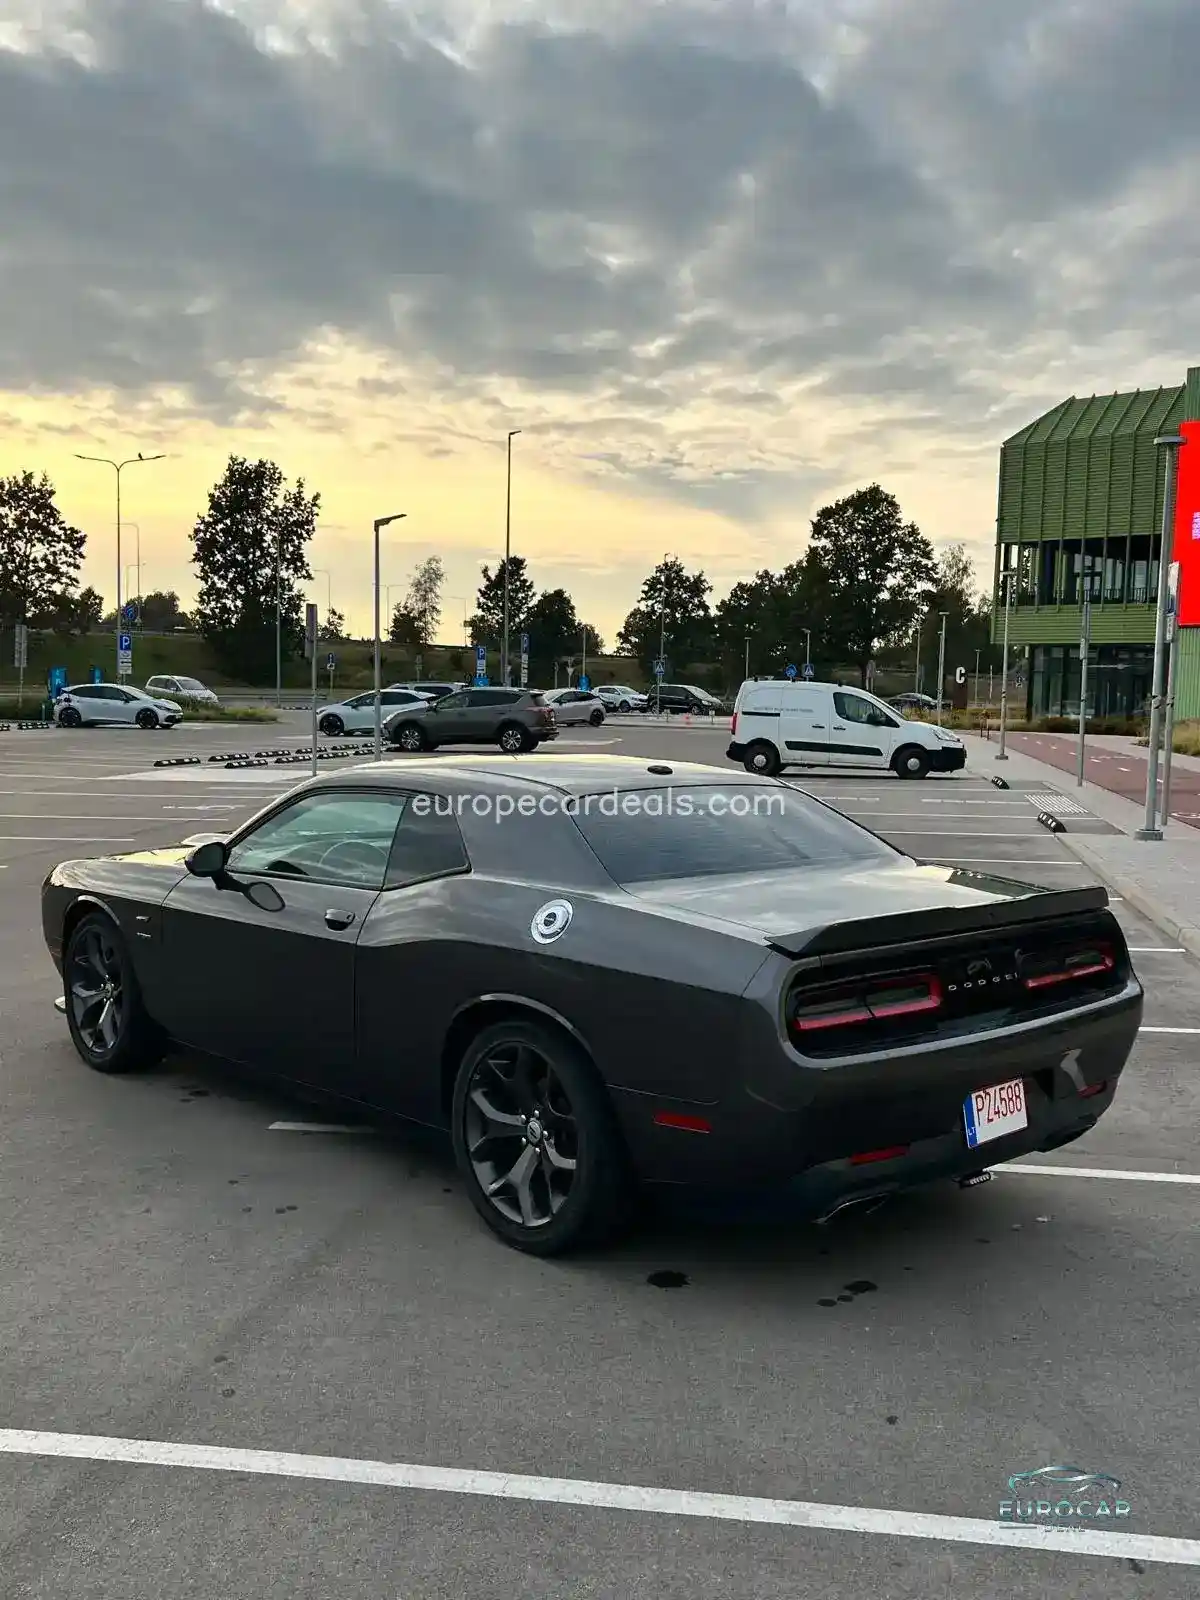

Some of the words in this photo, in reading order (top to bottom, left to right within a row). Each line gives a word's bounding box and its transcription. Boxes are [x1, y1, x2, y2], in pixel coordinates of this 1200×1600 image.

[122, 636, 130, 649] P
[955, 666, 966, 684] C
[948, 974, 1015, 991] DODGE
